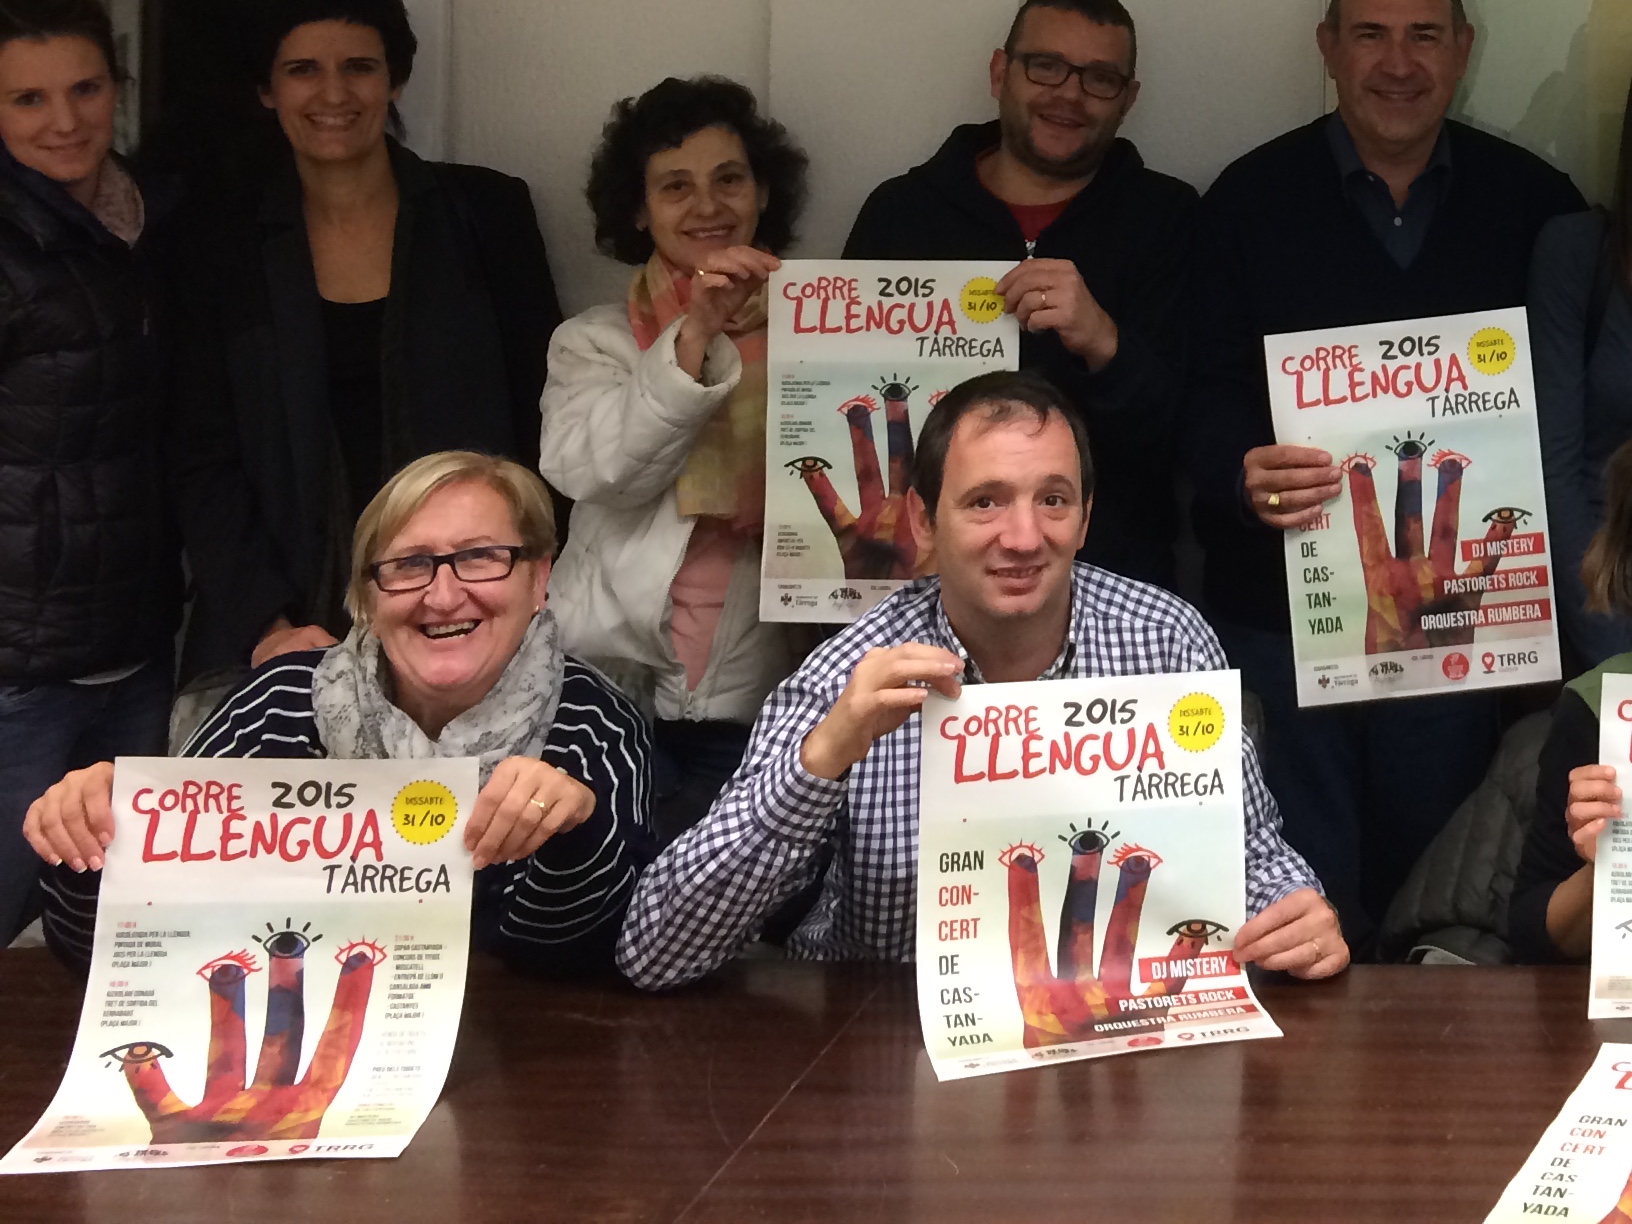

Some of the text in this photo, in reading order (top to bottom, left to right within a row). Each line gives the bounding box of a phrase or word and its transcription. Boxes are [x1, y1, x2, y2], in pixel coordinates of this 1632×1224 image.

[782, 276, 936, 302] CORRE 2015
[793, 297, 958, 335] LLENGUA
[967, 301, 997, 312] 31/10
[1281, 335, 1441, 376] CORRE 2015
[1477, 350, 1508, 364] 31/10
[1295, 352, 1469, 409] LLENGUA
[1301, 542, 1318, 559] DE
[1472, 536, 1534, 557] DJ MISTERY
[1303, 566, 1335, 584] CAS-
[1443, 570, 1539, 595] PASTORETS ROCK
[1305, 592, 1337, 610] TAN-
[1309, 616, 1343, 635] YADA
[1420, 604, 1542, 630] ORQUESTRA RUMBERA
[1498, 651, 1539, 667] TRRG
[940, 698, 1138, 740] CORRE 2015
[1178, 722, 1214, 737] 31/10
[954, 722, 1165, 783] LLENGUA
[132, 780, 357, 814] CORRE 2015
[402, 813, 446, 827] 31/10
[142, 809, 384, 863] LLENGUA
[939, 850, 985, 872] GRAN
[938, 885, 980, 906] CON-
[938, 918, 981, 941] CERT
[938, 954, 960, 975] DE
[1151, 955, 1228, 979] DJ MISTERY
[940, 987, 980, 1005] CAS-
[1119, 987, 1236, 1011] PASTORETS ROCK
[943, 1012, 984, 1029] TAN-
[1094, 1006, 1246, 1033] ORQUESTRA RUMBERA
[947, 1033, 994, 1047] YADA
[1199, 1026, 1250, 1038] TRRG
[1578, 1115, 1627, 1127] GRAN
[314, 1142, 374, 1153] TRRG
[1560, 1142, 1606, 1155] CERT
[1550, 1157, 1573, 1168] DE
[1532, 1185, 1575, 1200] TAN-
[1521, 1202, 1570, 1218] YADA
